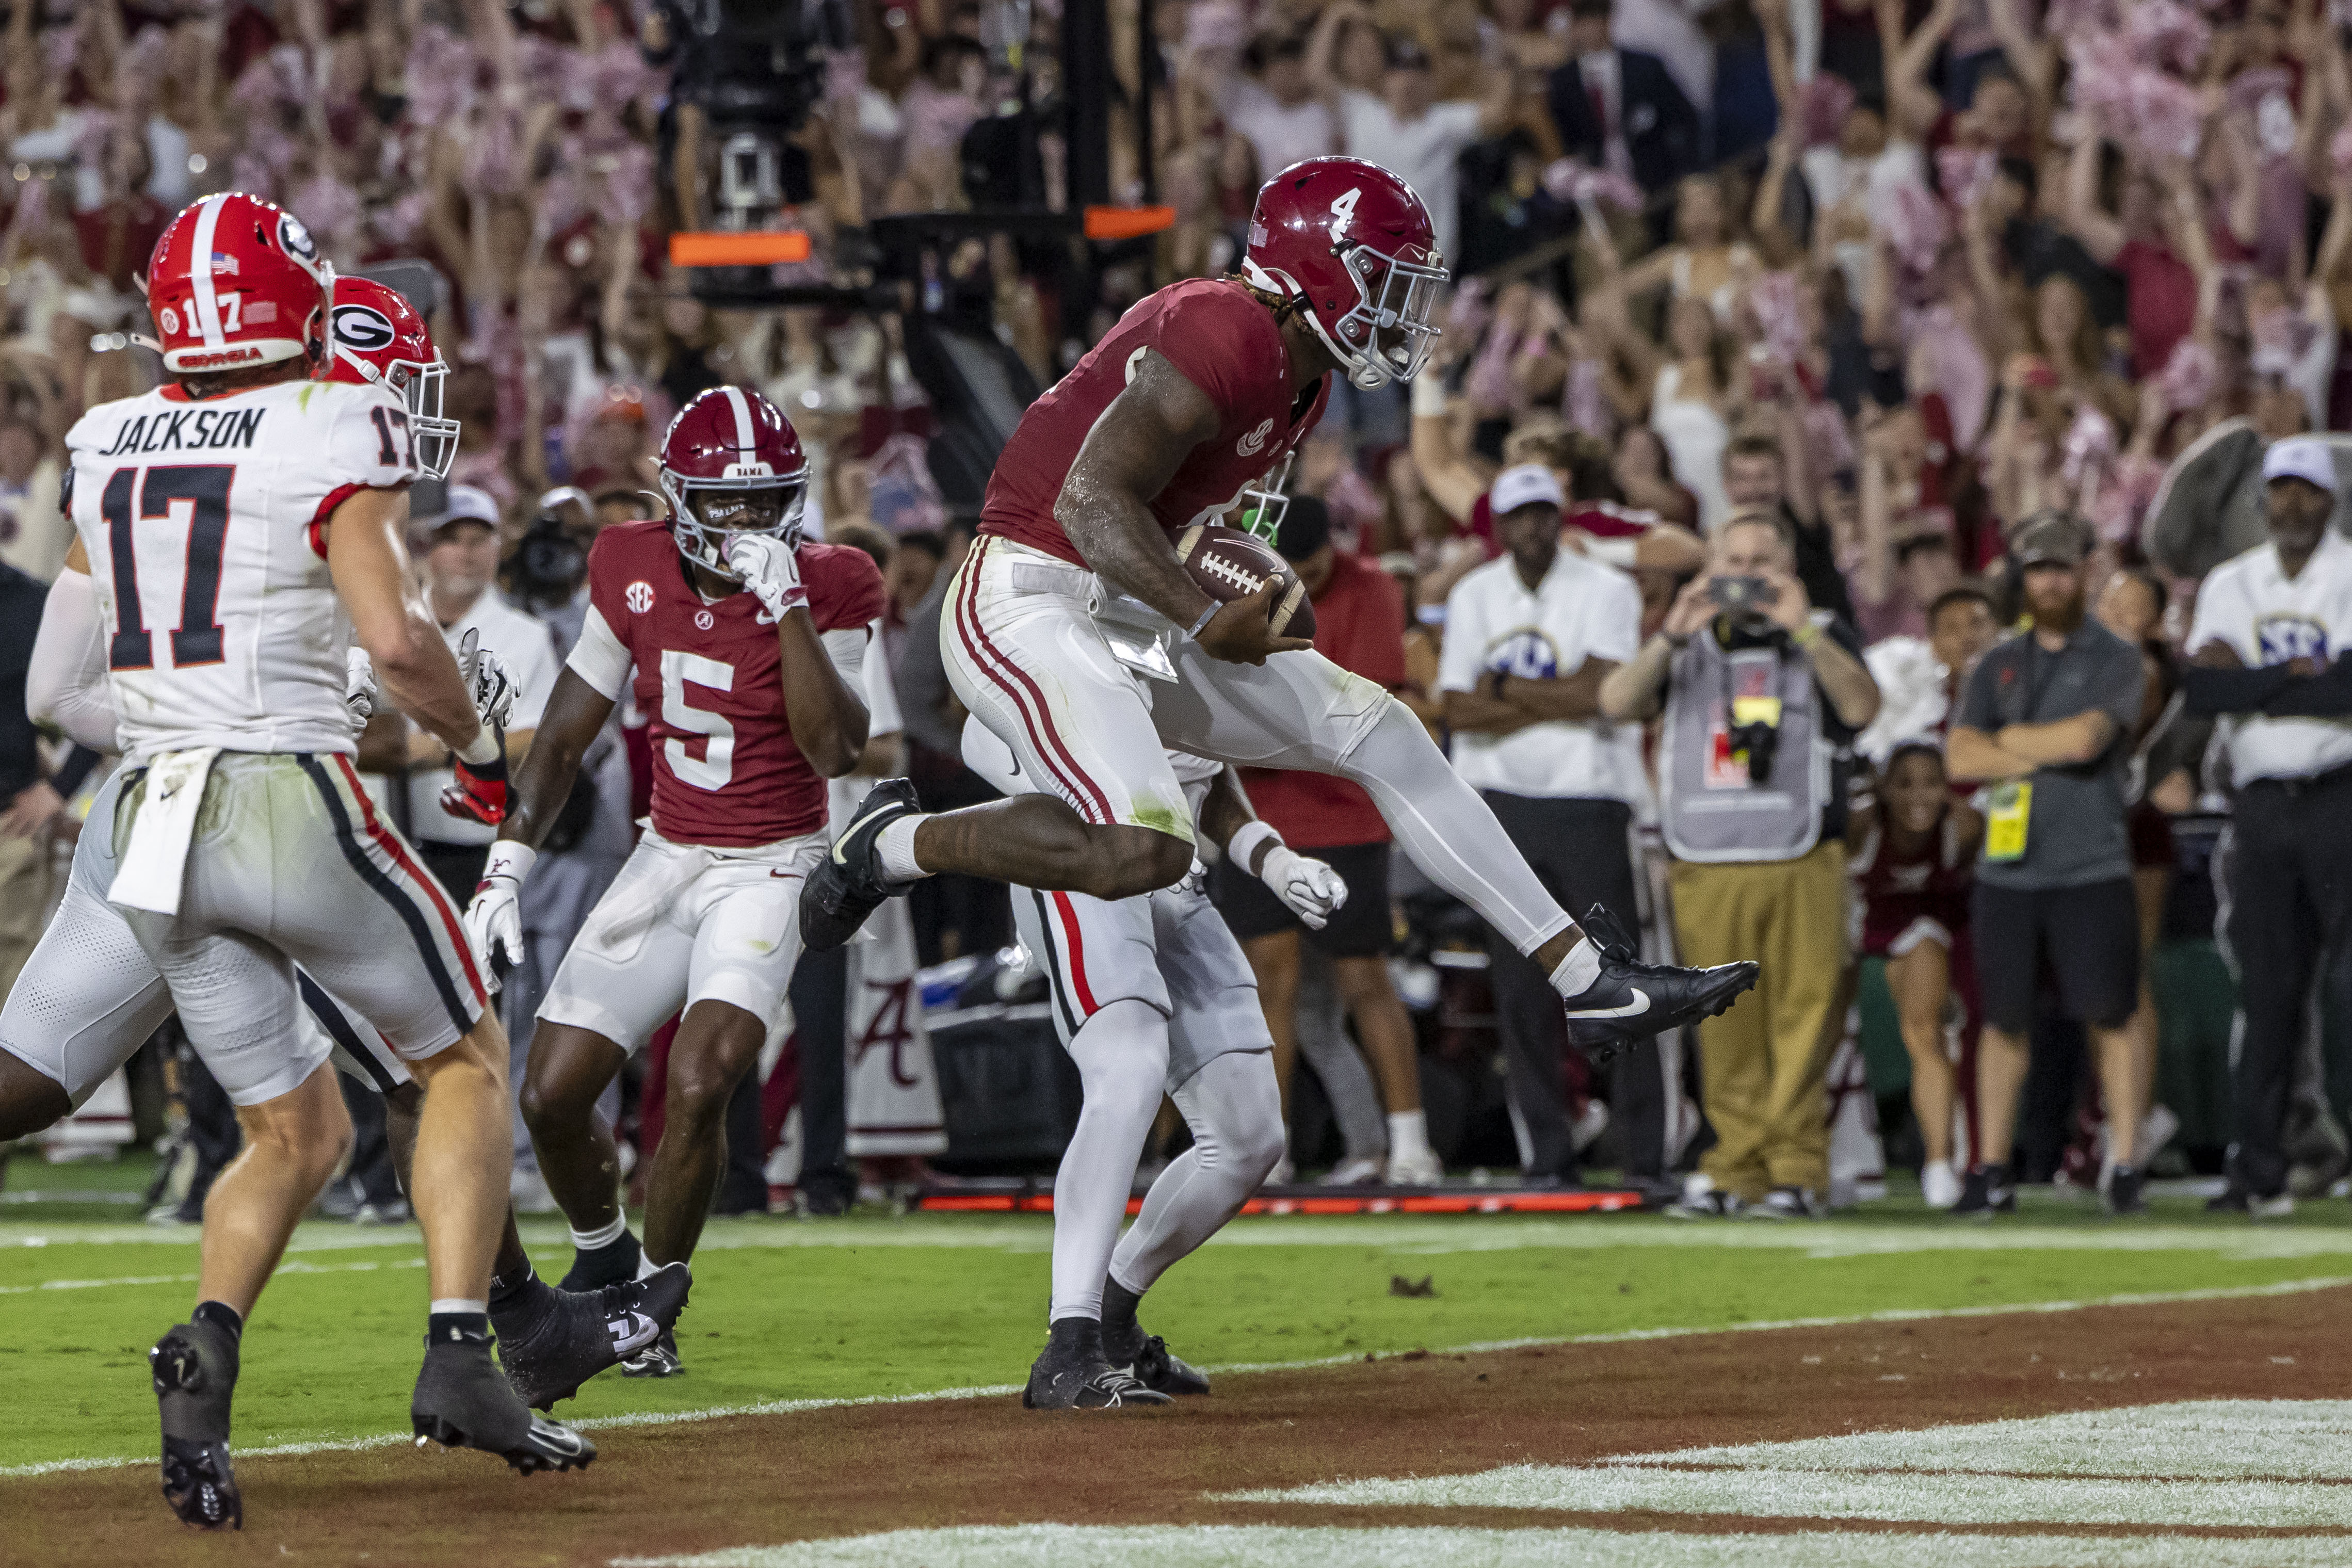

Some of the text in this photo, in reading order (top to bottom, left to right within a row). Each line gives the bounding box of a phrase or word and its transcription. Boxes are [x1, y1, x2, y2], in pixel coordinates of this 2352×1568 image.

[1330, 187, 1362, 234] 4
[182, 291, 242, 338] 17
[332, 304, 394, 350] G
[98, 408, 267, 456] JACKSON
[100, 464, 237, 672] 17
[625, 581, 654, 615] SEC
[660, 649, 735, 792] 5
